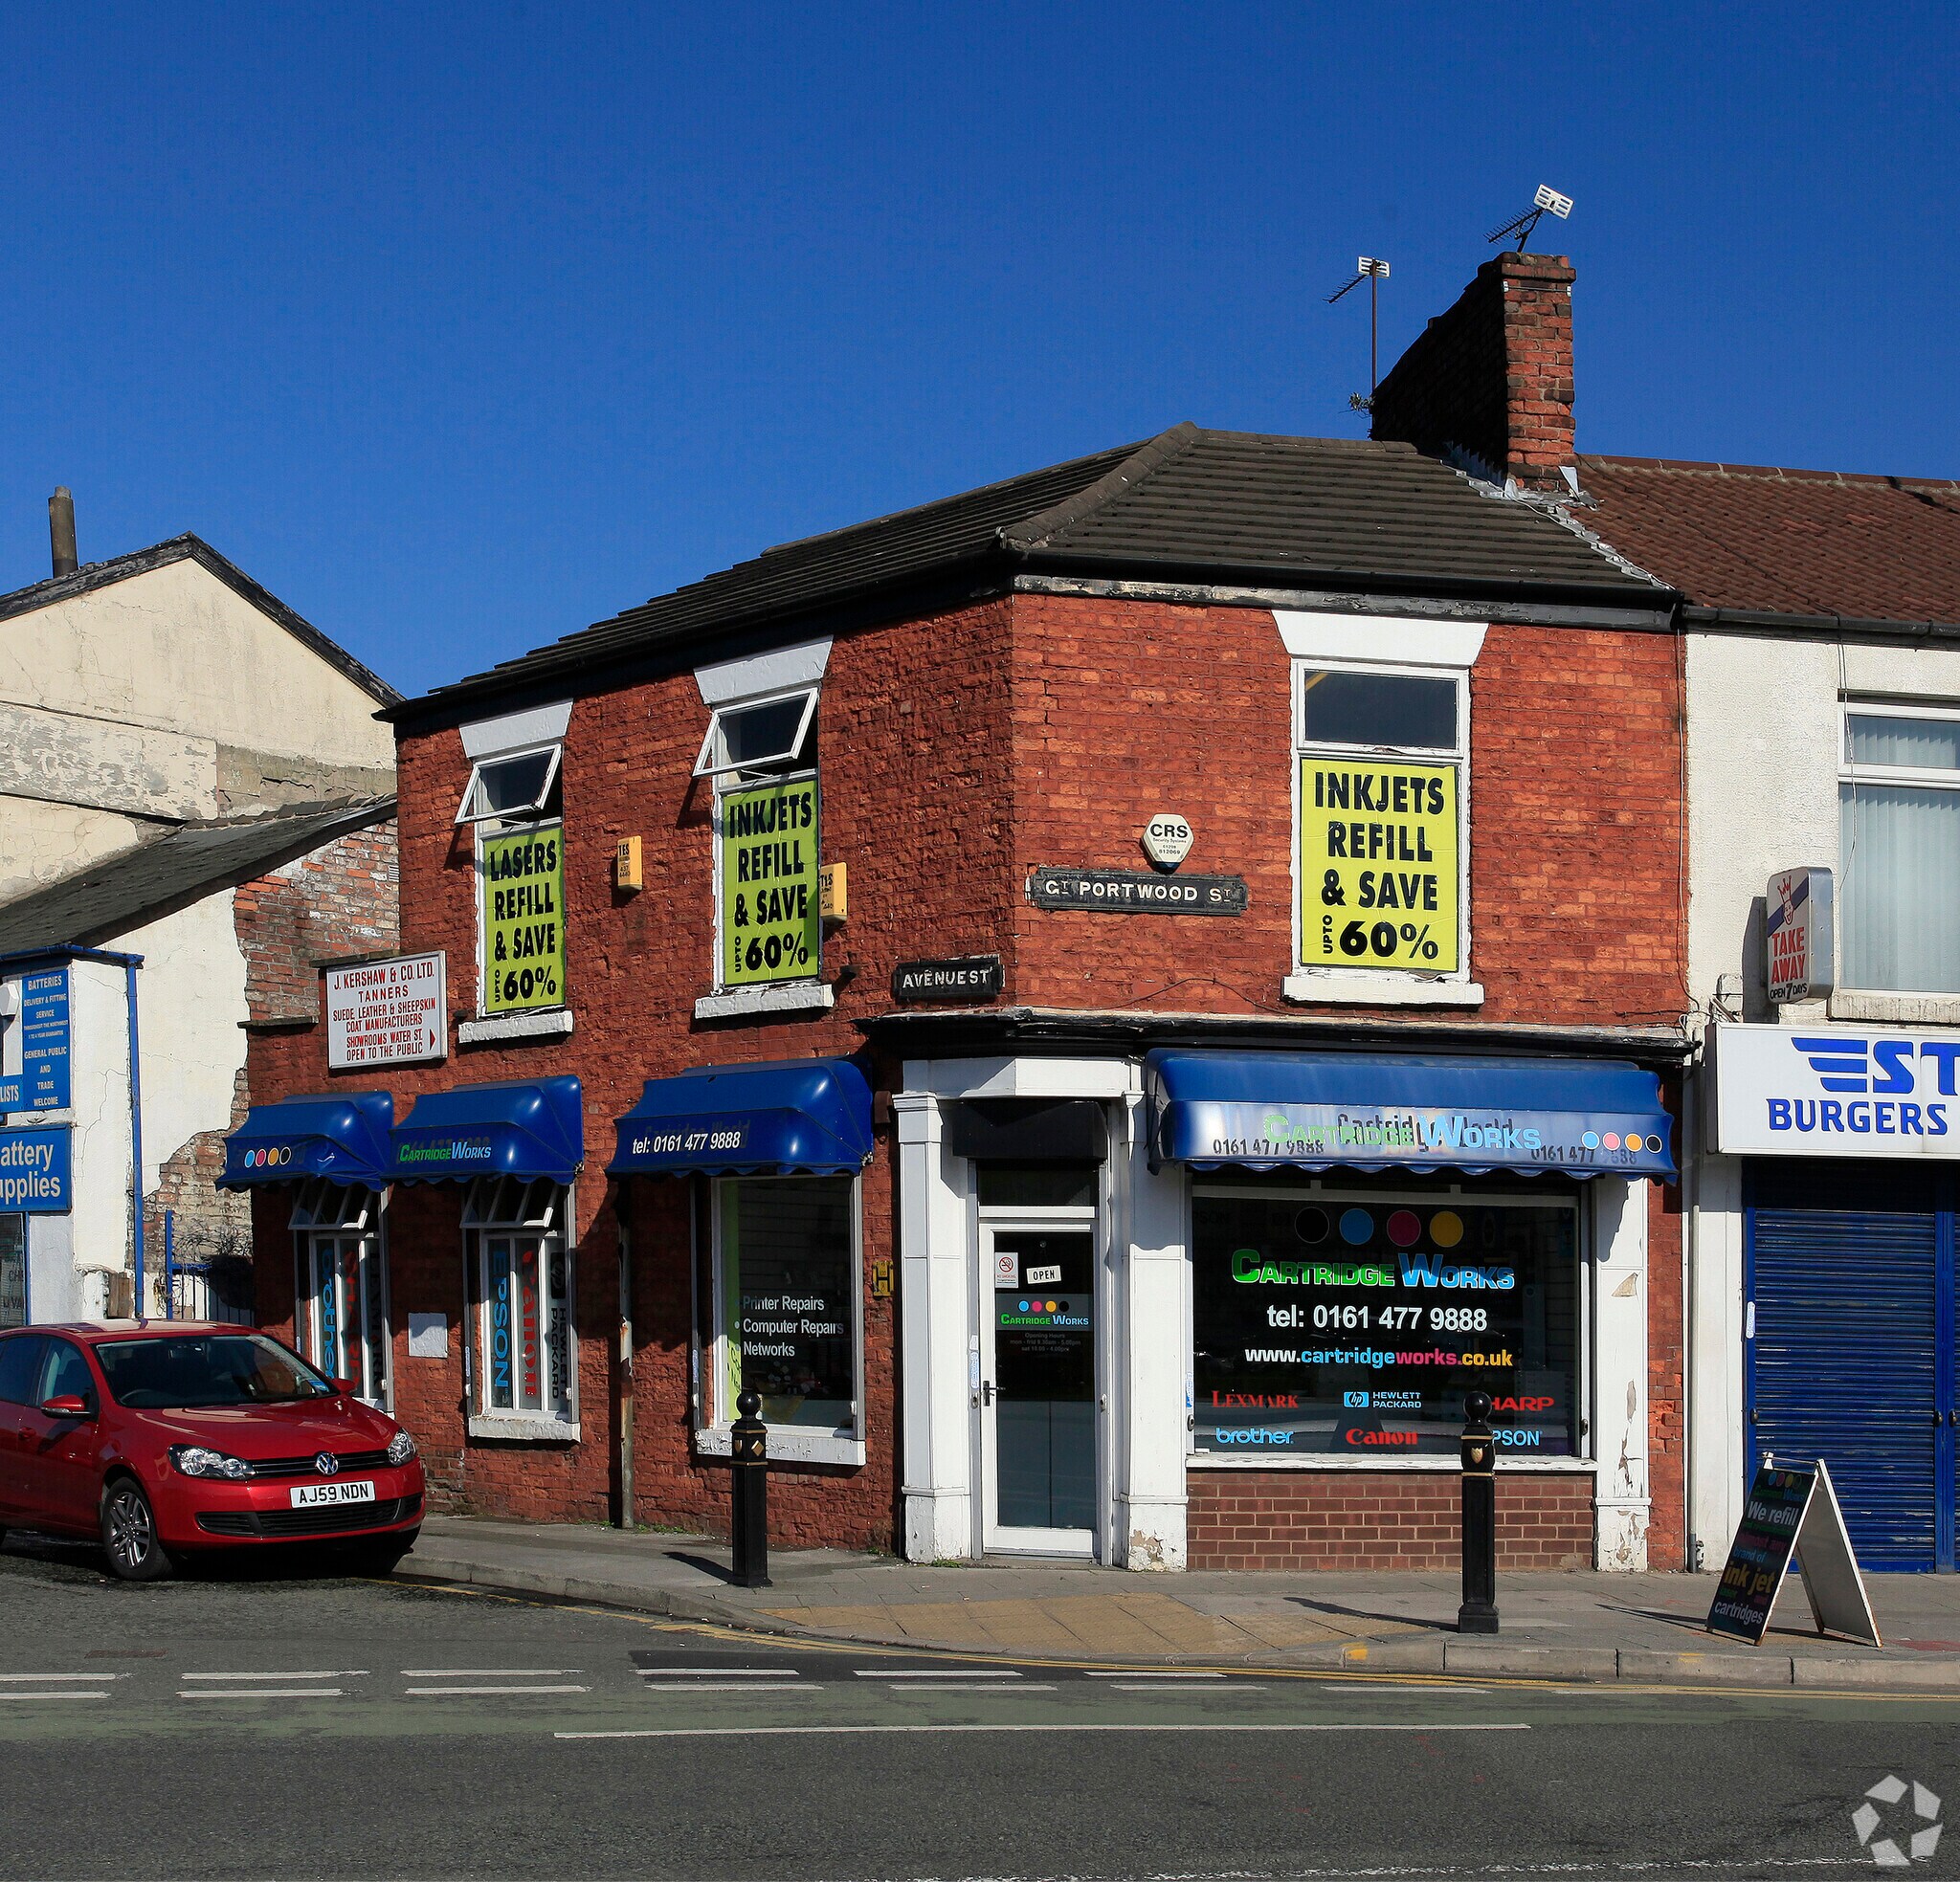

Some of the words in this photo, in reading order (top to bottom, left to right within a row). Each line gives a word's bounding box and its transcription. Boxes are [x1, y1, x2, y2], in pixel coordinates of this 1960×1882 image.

[1315, 772, 1445, 815] INKJETS
[730, 792, 812, 838] INKJETS
[1150, 824, 1188, 838] CRS
[1328, 821, 1433, 862] REFILL
[490, 840, 557, 882] LASERS
[738, 840, 804, 882] REFILL
[1079, 881, 1198, 902] PORTWOOD
[1321, 869, 1347, 907] &
[1358, 871, 1438, 911] SAVE
[495, 882, 555, 921] REFILL
[735, 893, 749, 928] &
[757, 884, 807, 925] SAVE
[495, 930, 508, 962] &
[512, 923, 556, 960] SAVE
[1340, 920, 1438, 959] 60%
[1771, 927, 1805, 957] TAKE
[745, 931, 808, 971] 60%
[334, 975, 342, 990] J.
[345, 968, 386, 989] KERSHAW
[390, 967, 397, 983] &
[401, 964, 415, 981] CO.
[417, 961, 434, 979] LTD.
[902, 969, 967, 988] AVENUE
[1771, 953, 1806, 984] AWAY
[28, 975, 62, 991] BATTERIES
[358, 985, 409, 1003] TANNERS
[503, 965, 557, 1001] 60%
[1770, 988, 1786, 999] OPEN
[1785, 983, 1793, 1000] 7
[1793, 983, 1808, 995] DAYS
[24, 997, 45, 1007] DELIVERY
[49, 993, 67, 1003] FITTING
[333, 1007, 355, 1022] SUEDE
[358, 1003, 387, 1019] LEATHER
[390, 1004, 395, 1015] &
[398, 997, 436, 1015] SHEEPSKIN
[35, 1009, 55, 1019] SERVICE
[346, 1020, 362, 1033] COAT
[365, 1013, 423, 1032] MANUFACTURERS
[346, 1033, 388, 1049] SHOWROOMS
[390, 1030, 412, 1044] WATER
[24, 1049, 47, 1060] GENERAL
[47, 1046, 67, 1057] PUBLIC
[346, 1048, 365, 1063] OPEN
[368, 1047, 377, 1060] TO
[379, 1045, 394, 1058] THE
[397, 1042, 423, 1057] PUBLIC
[40, 1064, 51, 1074] AND
[37, 1081, 54, 1090] TRADE
[33, 1096, 58, 1107] WELCOME
[1766, 1098, 1948, 1136] BURGERS
[632, 1137, 651, 1154] tel:
[653, 1134, 682, 1153] 0161
[684, 1133, 709, 1151] 477
[710, 1131, 741, 1150] 9888
[1417, 1115, 1542, 1149] WORKS
[1214, 1139, 1247, 1155] 0161
[0, 1171, 61, 1205] pplies
[1033, 1270, 1055, 1281] OPEN
[743, 1295, 779, 1311] Printer
[781, 1295, 824, 1314] Repairs
[493, 1251, 509, 1387] EPSON
[523, 1251, 537, 1395] Canon
[743, 1318, 798, 1336] Computer
[801, 1319, 844, 1338] Repairs
[1267, 1305, 1304, 1328] tel:
[1313, 1305, 1369, 1328] 0161
[1379, 1306, 1423, 1330] 477
[1429, 1307, 1488, 1331] 9888
[743, 1341, 795, 1357] Networks
[1245, 1347, 1513, 1368] www.cartridgeworks.co.uk
[1215, 1427, 1294, 1445] brother
[1345, 1428, 1418, 1445] Canon
[300, 1486, 337, 1503] AJ59
[341, 1483, 369, 1499] NDN
[1747, 1501, 1767, 1521] We
[1768, 1506, 1799, 1527] refill
[1733, 1546, 1756, 1561] brand
[1756, 1551, 1767, 1562] of
[1769, 1539, 1787, 1555] any
[1724, 1561, 1750, 1588] ink
[1747, 1567, 1776, 1595] jet
[1715, 1601, 1764, 1626] cartridges
